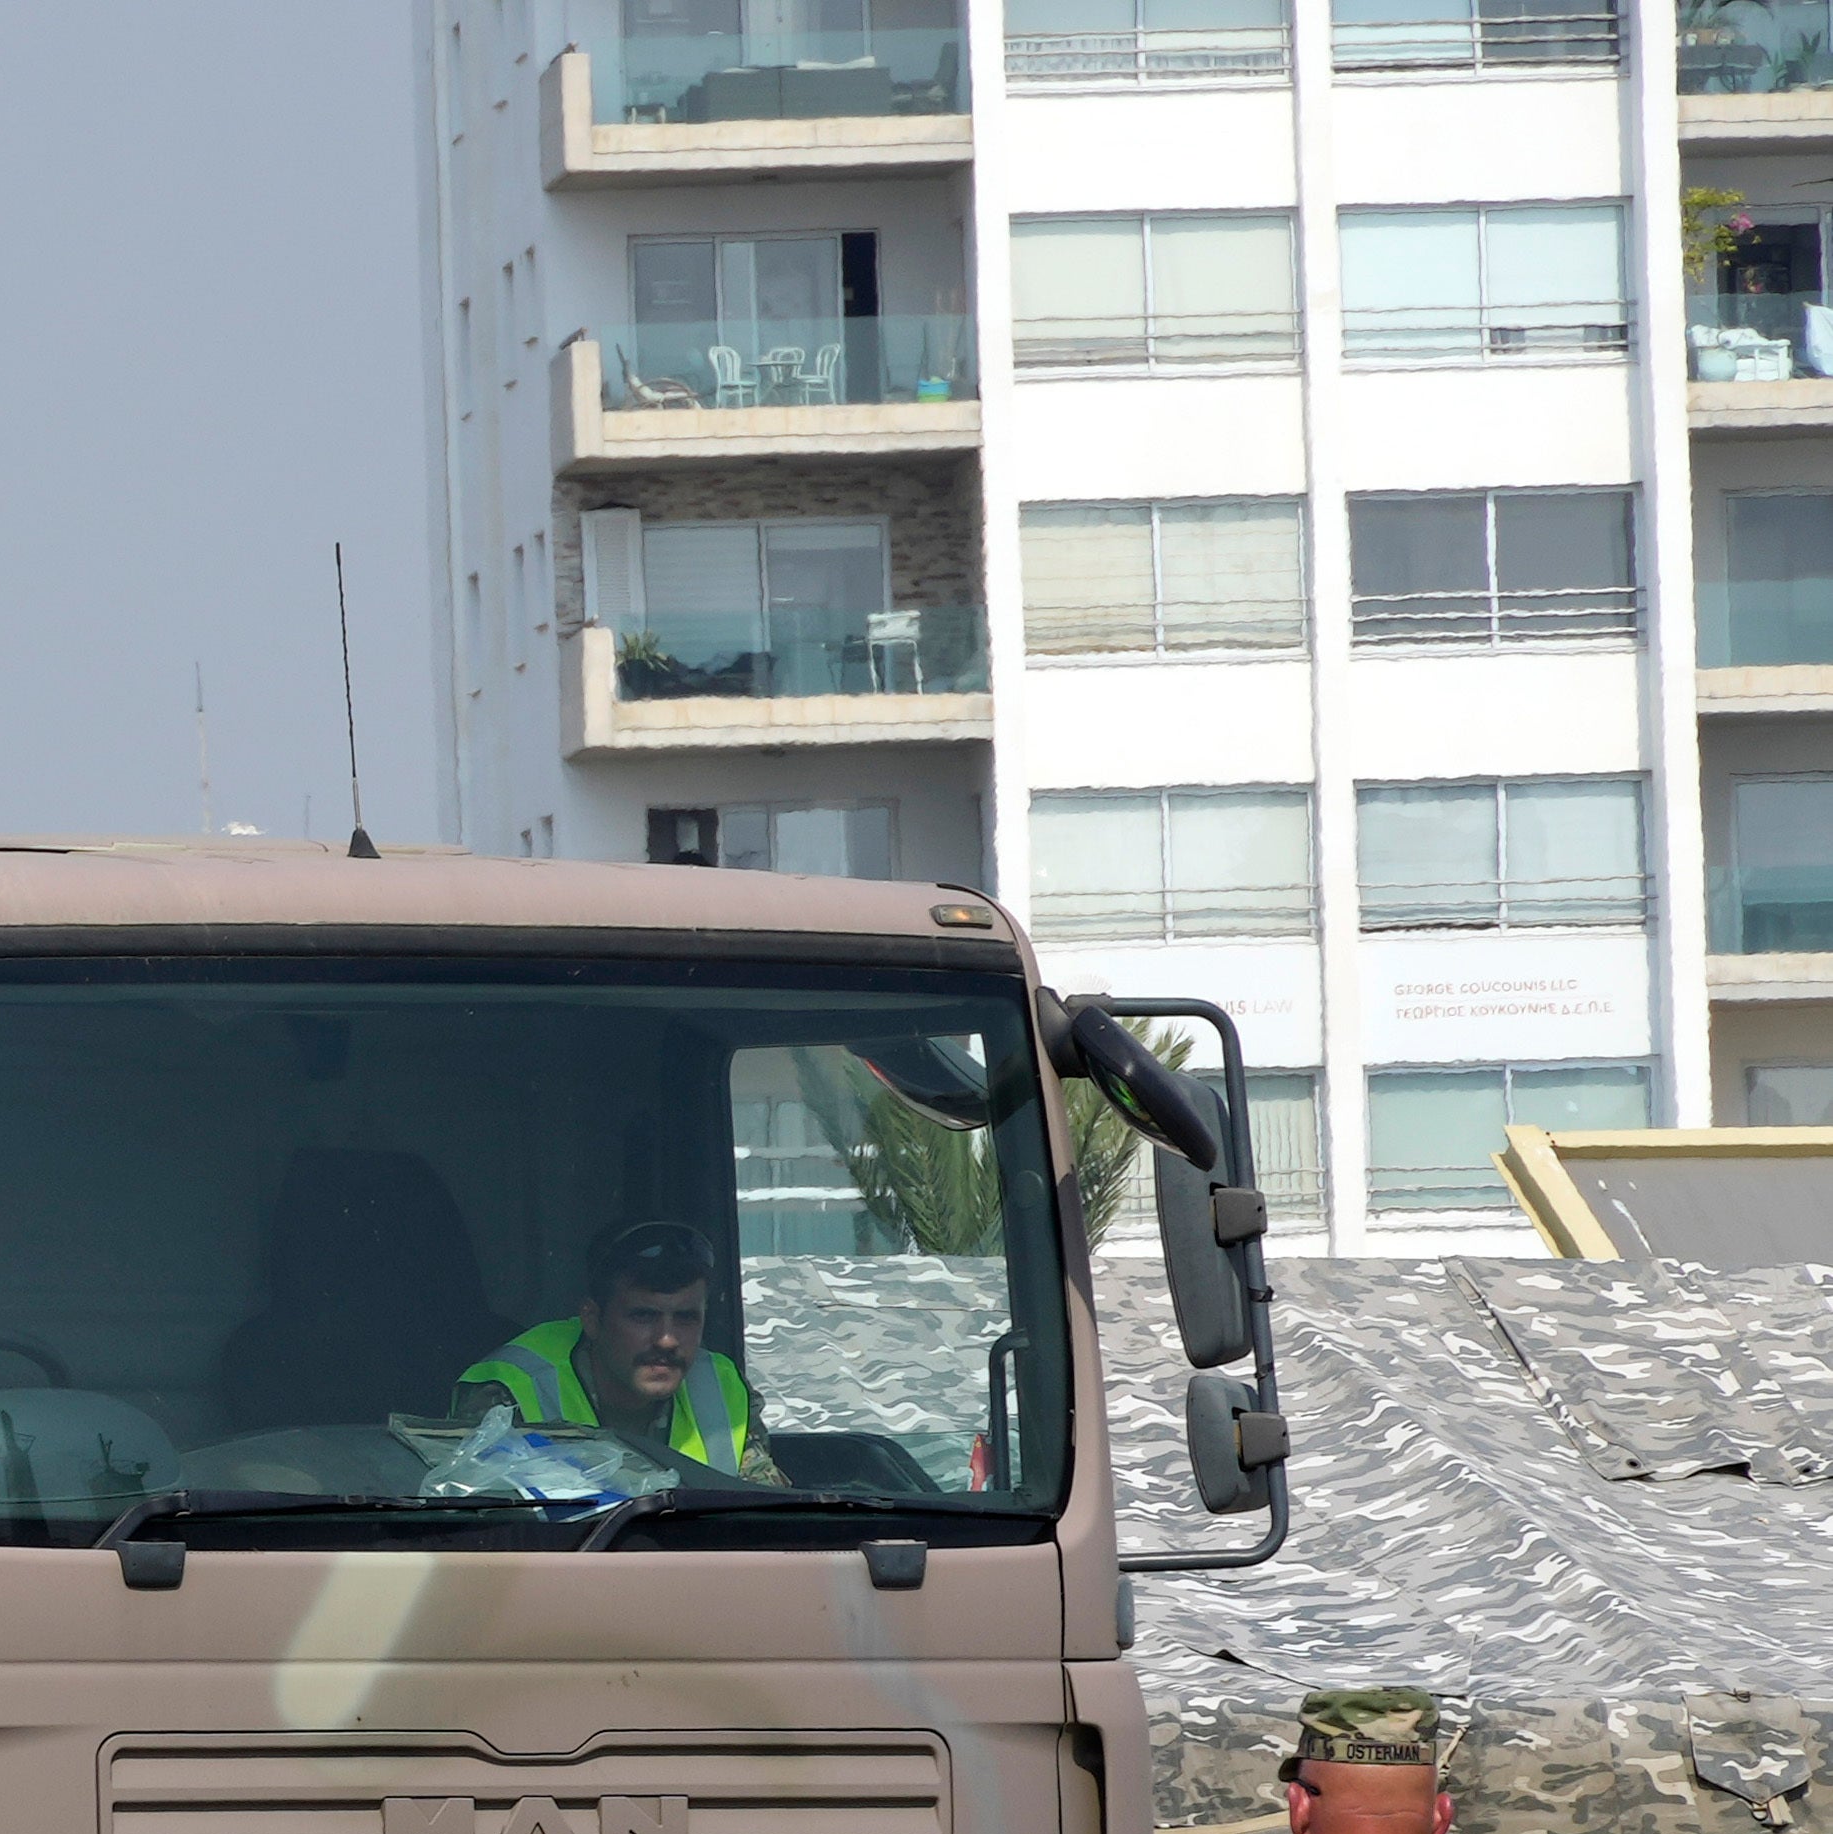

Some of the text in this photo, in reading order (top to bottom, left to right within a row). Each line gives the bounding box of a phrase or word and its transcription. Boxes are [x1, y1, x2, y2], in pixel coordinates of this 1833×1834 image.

[1394, 979, 1578, 996] GEORGE COUCOUNIS LLC
[1346, 1743, 1421, 1761] OSTERMAN
